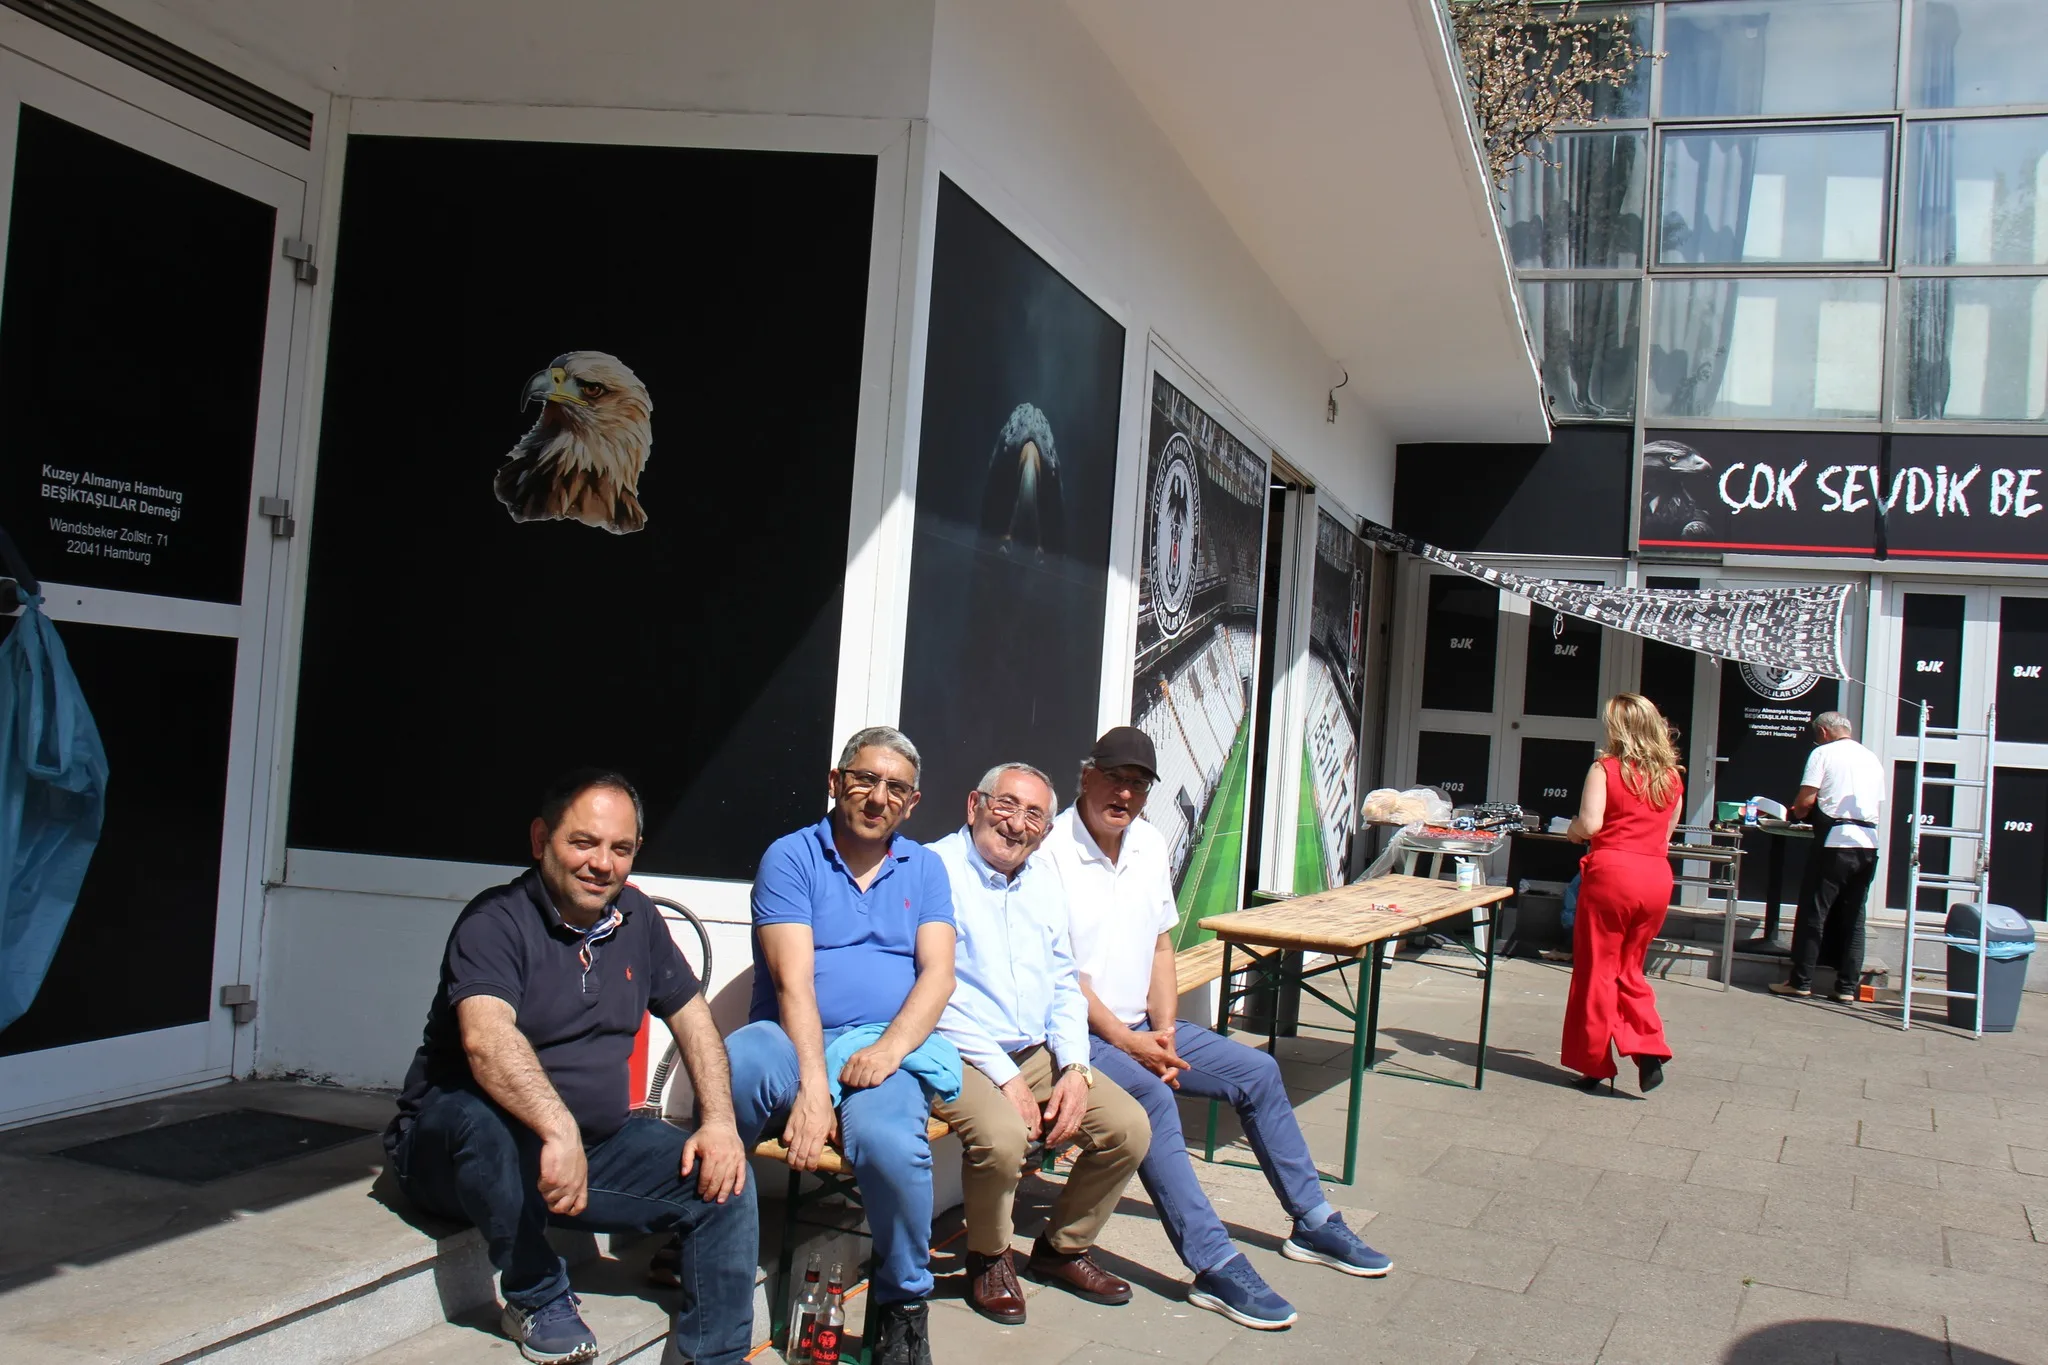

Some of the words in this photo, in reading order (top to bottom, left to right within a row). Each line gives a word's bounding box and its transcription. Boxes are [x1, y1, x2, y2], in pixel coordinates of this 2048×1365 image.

[42, 464, 80, 483] Kuzey
[82, 471, 131, 493] Almanya
[134, 481, 183, 504] Hamburg
[1718, 459, 1809, 517] ÇOK
[1815, 463, 1984, 518] SEVDİK
[1989, 468, 2045, 518] BE
[40, 484, 137, 512] BEŞİKTAŞLILAR
[139, 501, 181, 521] Derneği
[50, 518, 118, 539] Wandsbeker
[120, 528, 153, 544] Zollstr.
[156, 534, 168, 547] 71
[66, 540, 100, 556] 22041
[104, 545, 151, 566] Hamburg
[1450, 638, 1474, 650] BJK
[1554, 644, 1578, 657] BJK
[1916, 660, 1944, 673] BJK
[2013, 665, 2042, 679] BJK
[1744, 706, 1761, 714] Kuzey
[1440, 782, 1464, 792] 1903
[1543, 788, 1568, 798] 1903
[1906, 814, 1935, 825] 103
[2004, 820, 2033, 833] 1903
